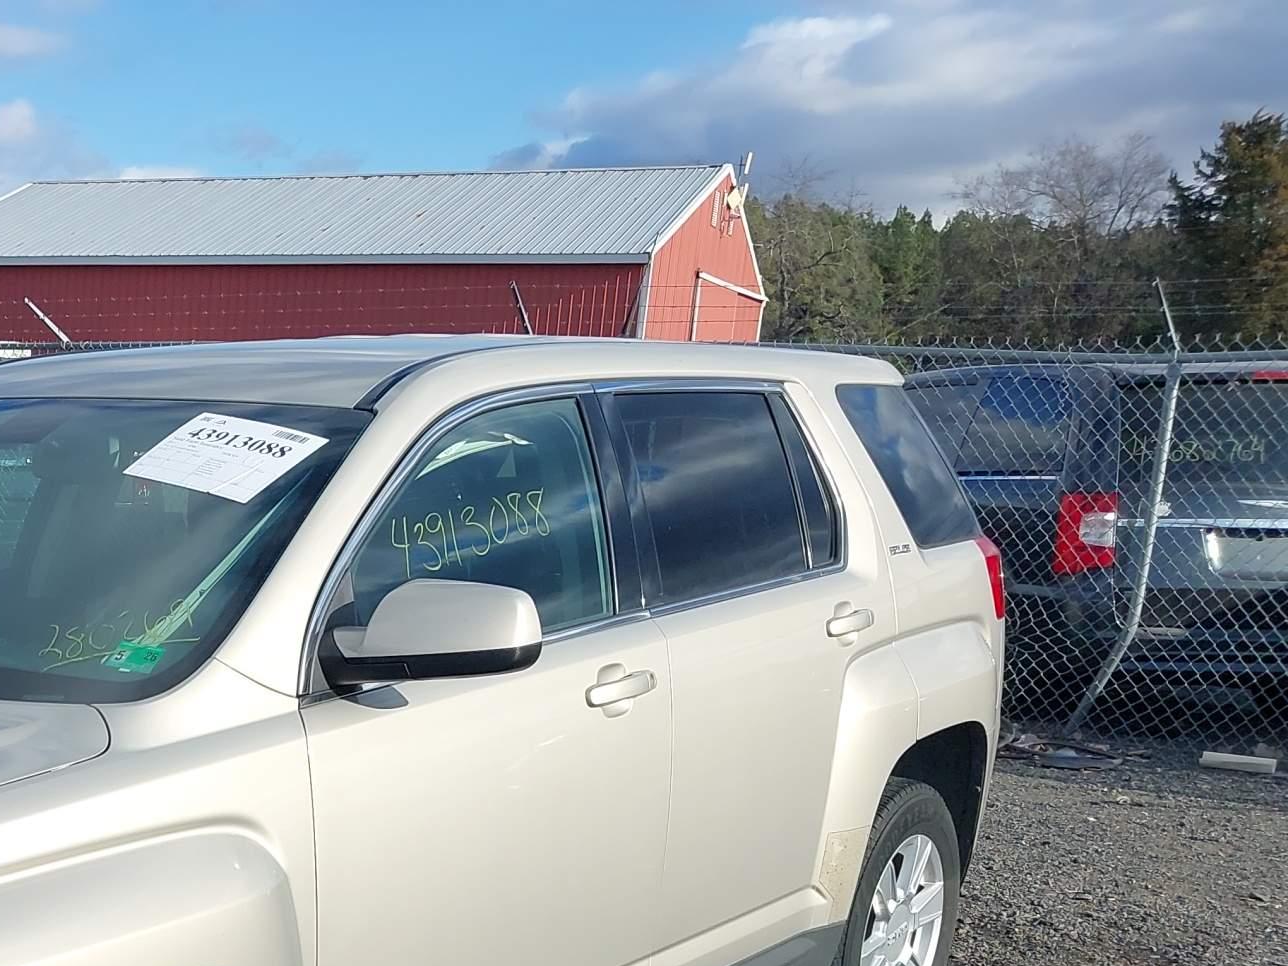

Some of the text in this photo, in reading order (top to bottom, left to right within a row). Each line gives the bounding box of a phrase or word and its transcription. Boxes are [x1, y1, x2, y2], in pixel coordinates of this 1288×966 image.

[187, 427, 293, 458] 43913088
[392, 488, 551, 579] 43913088
[115, 650, 126, 661] 5
